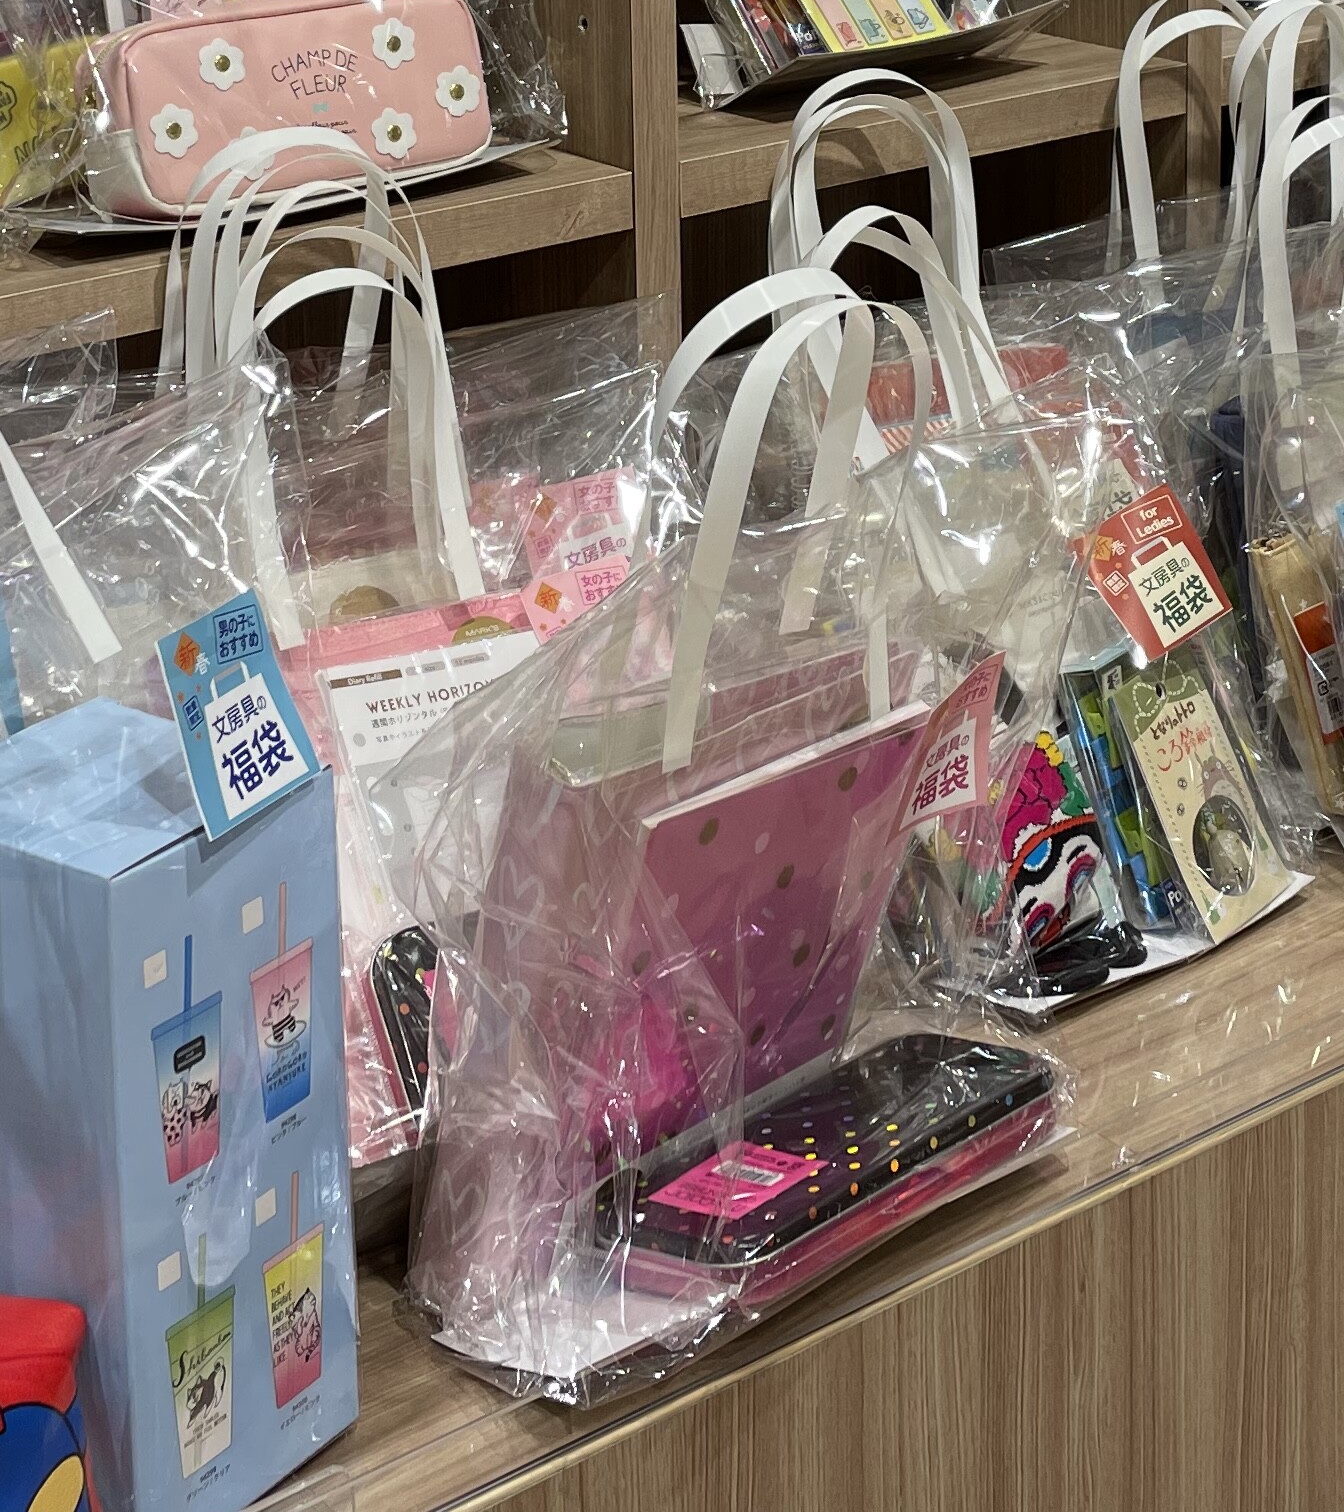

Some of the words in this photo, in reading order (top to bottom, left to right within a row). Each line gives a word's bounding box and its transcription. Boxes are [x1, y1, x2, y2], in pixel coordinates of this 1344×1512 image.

[271, 49, 331, 83] CHAMP
[336, 49, 358, 73] DE
[289, 74, 347, 100] FLEUR
[1136, 515, 1175, 538] Ledies
[1139, 506, 1158, 521] for
[564, 536, 627, 569] 文房具の
[581, 571, 623, 588] 女の子に
[1138, 557, 1190, 597] 文房具の
[1153, 574, 1213, 633] 福袋
[219, 614, 256, 639] 男の子に
[220, 632, 260, 659] おすすめ
[212, 694, 267, 744] 文房具の
[366, 694, 422, 714] WEEKLY
[1150, 700, 1197, 741] となりのトトロ
[221, 719, 294, 800] 福袋
[912, 754, 969, 815] 福袋
